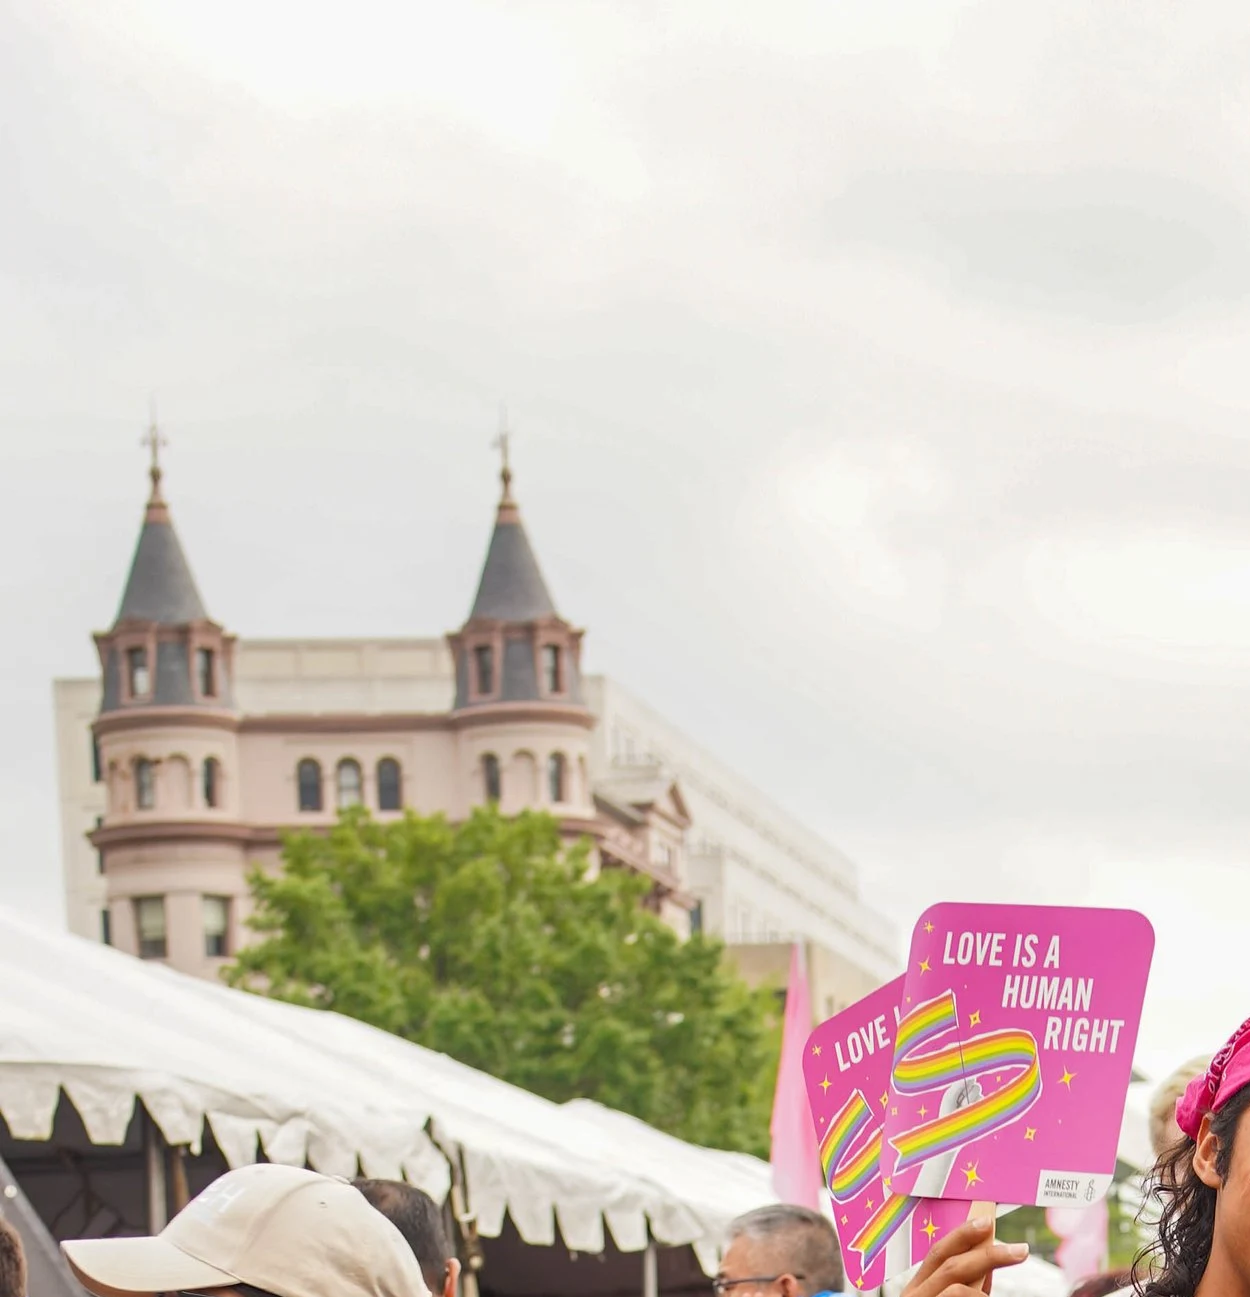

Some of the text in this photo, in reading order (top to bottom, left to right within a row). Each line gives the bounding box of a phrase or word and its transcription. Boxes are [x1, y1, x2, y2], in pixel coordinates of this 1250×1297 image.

[942, 931, 1060, 969] LOVE IS A
[1001, 974, 1094, 1012] HUMAN
[834, 1014, 891, 1072] LOVE
[1043, 1016, 1125, 1053] RIGHT
[1043, 1190, 1077, 1199] INTERNATIONAL
[1045, 1179, 1080, 1190] AMNESTY
